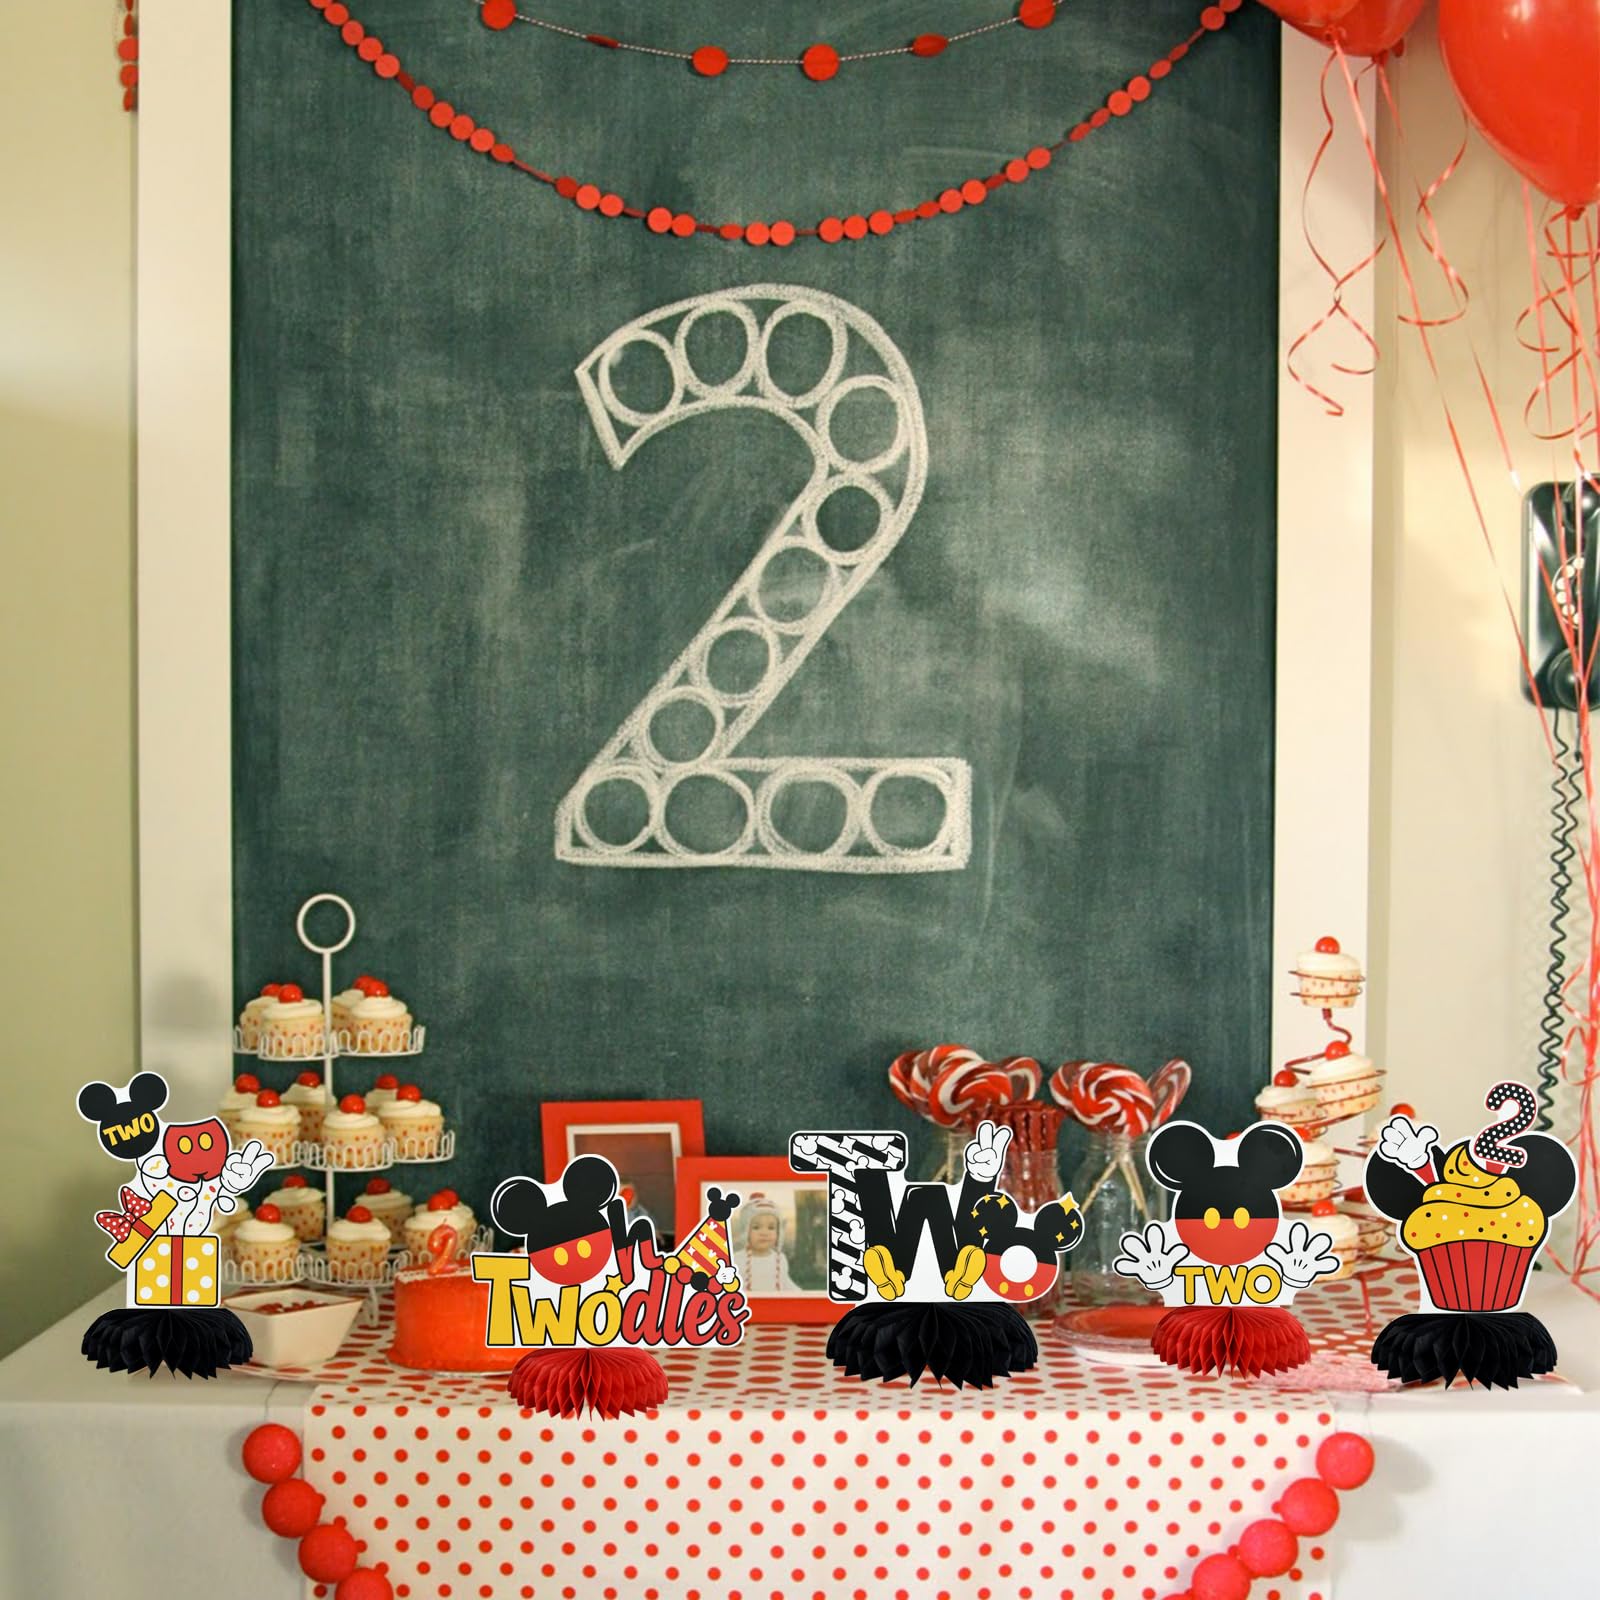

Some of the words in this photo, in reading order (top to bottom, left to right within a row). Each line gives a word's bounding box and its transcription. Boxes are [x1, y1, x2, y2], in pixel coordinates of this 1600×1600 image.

[554, 283, 972, 875] 2
[102, 1112, 155, 1147] TWO
[1473, 1082, 1536, 1167] 2
[1174, 1265, 1283, 1304] TWO
